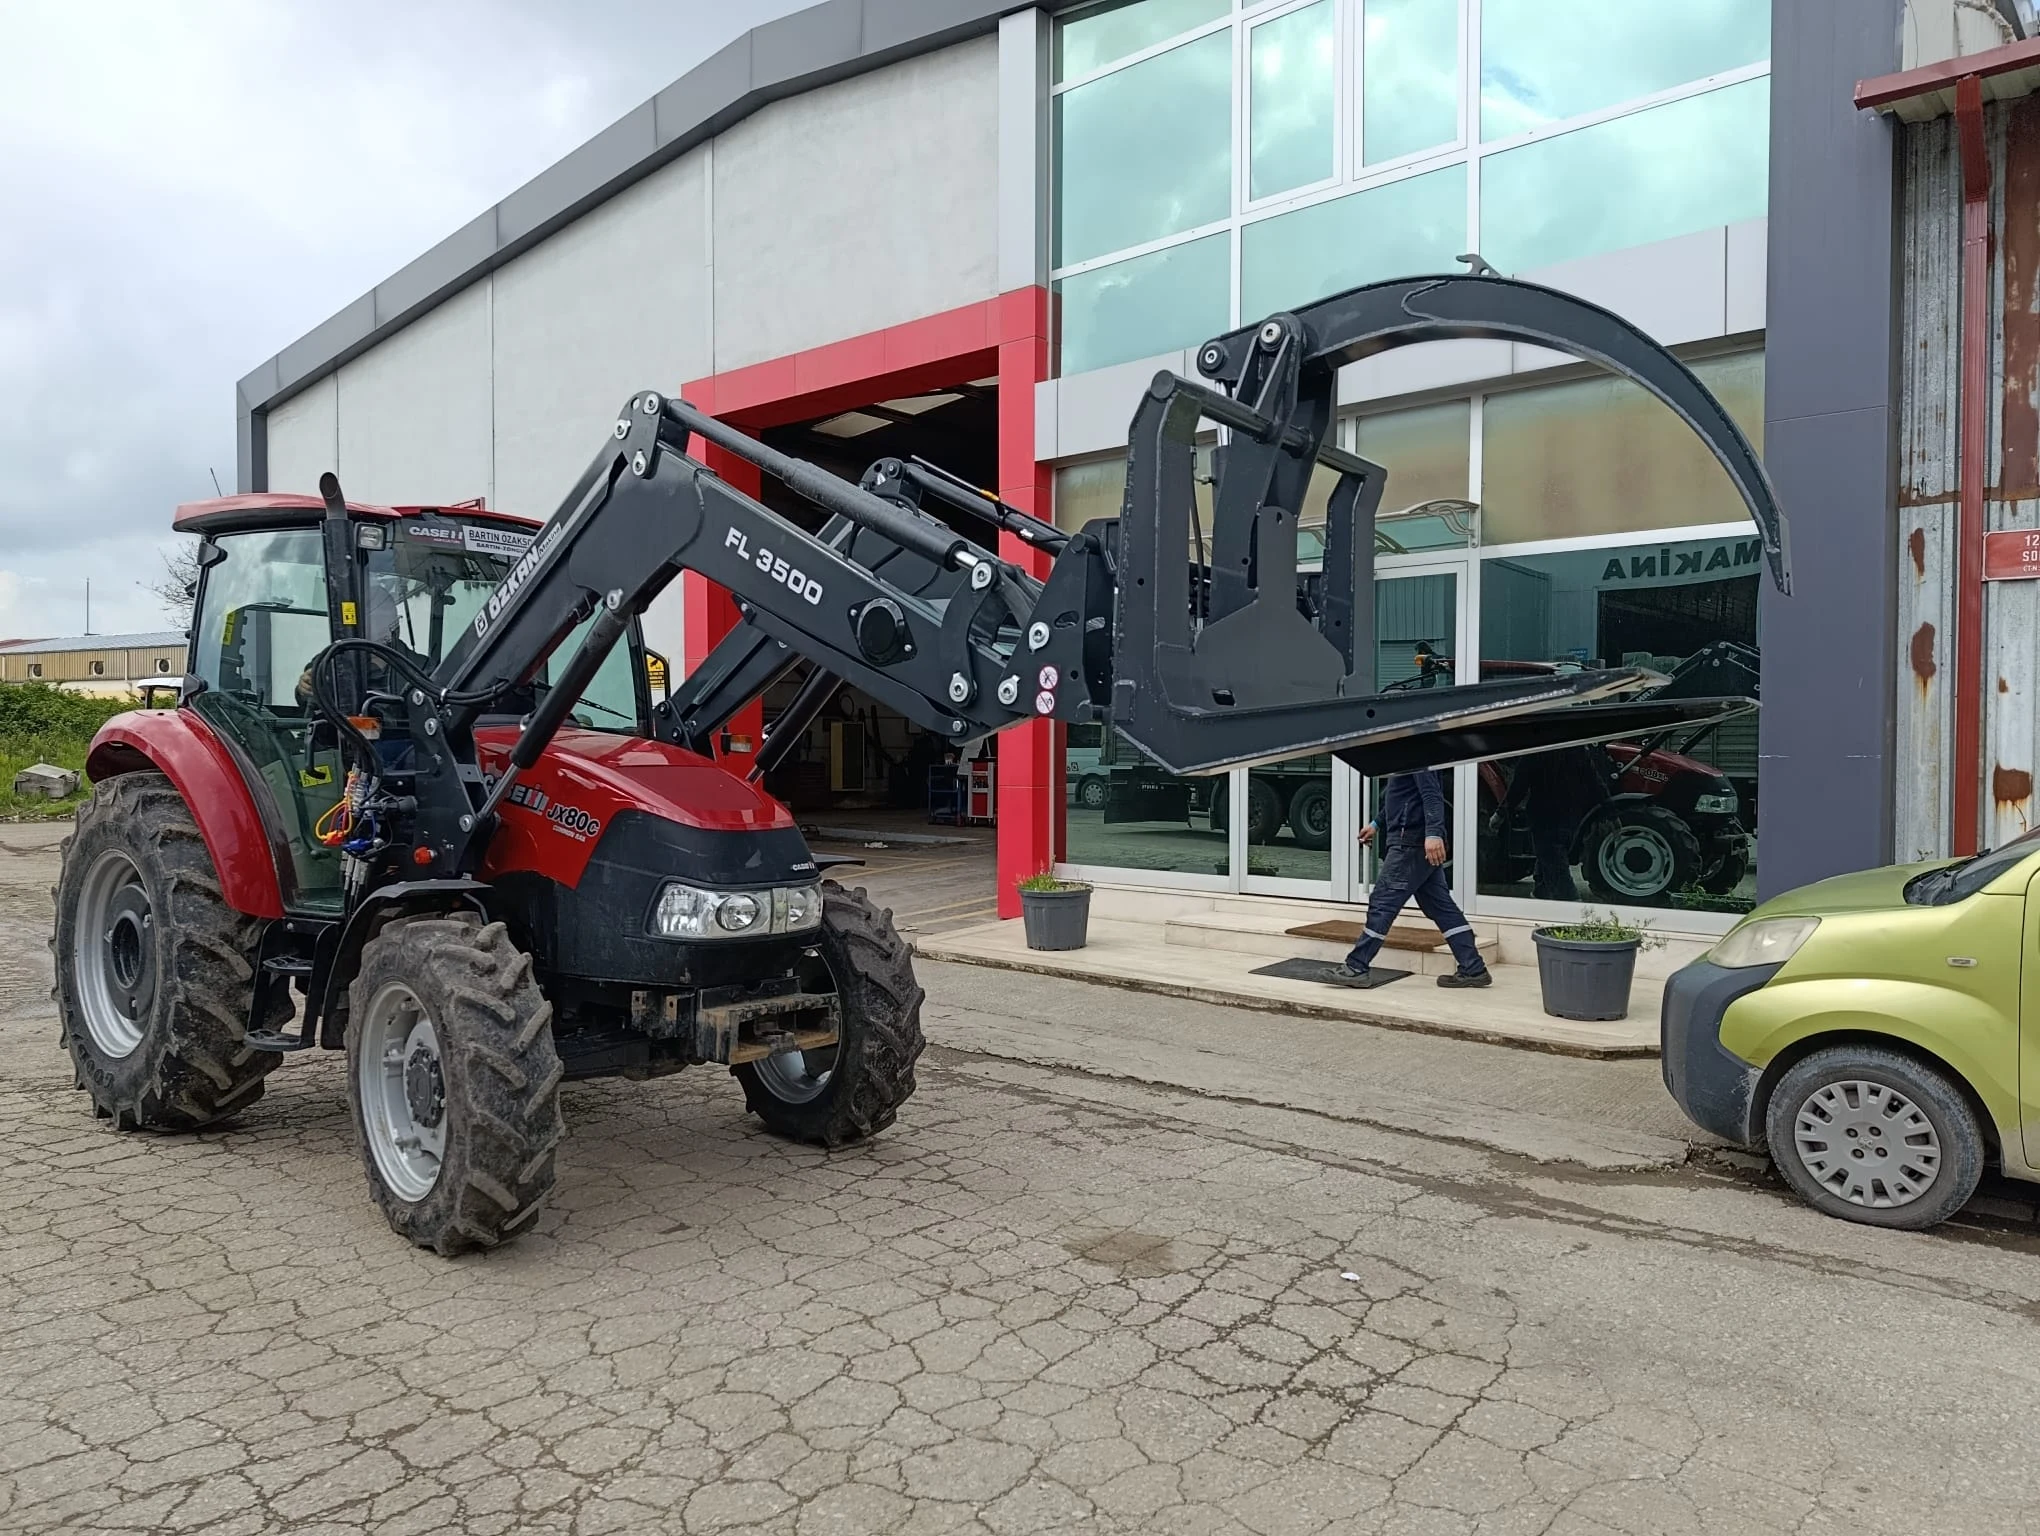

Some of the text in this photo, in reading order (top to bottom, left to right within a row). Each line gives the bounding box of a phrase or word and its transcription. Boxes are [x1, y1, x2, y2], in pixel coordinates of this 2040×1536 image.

[409, 526, 449, 538] CASE
[469, 529, 500, 542] BARTIN
[488, 545, 541, 620] ÖZKAN
[724, 526, 823, 605] FL 3500
[546, 803, 600, 837] JX80C
